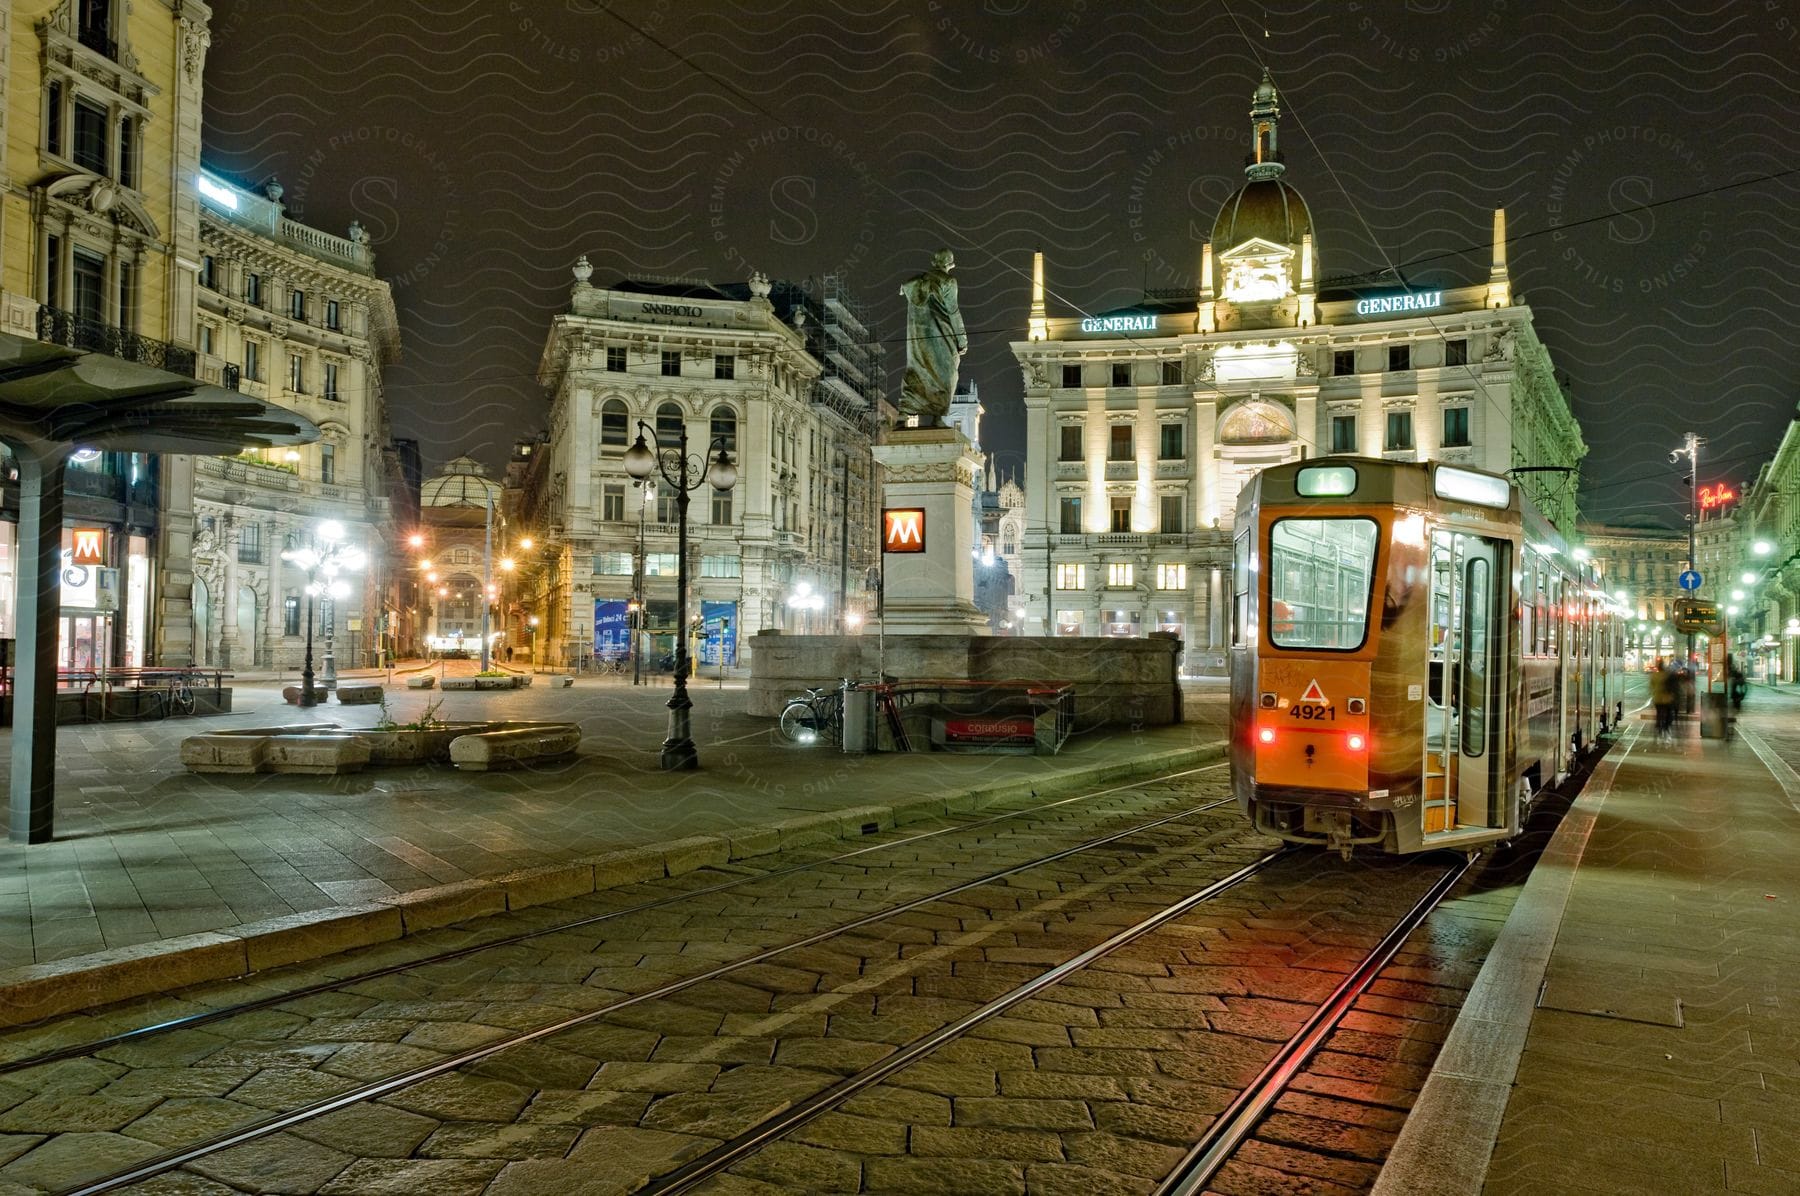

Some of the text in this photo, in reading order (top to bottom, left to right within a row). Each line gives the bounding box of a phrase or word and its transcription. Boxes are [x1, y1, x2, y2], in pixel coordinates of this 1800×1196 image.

[641, 303, 703, 318] SANPAOLO
[1357, 292, 1441, 315] GENERALI
[1081, 316, 1157, 332] GENERALI
[1699, 483, 1733, 507] Ray-Ban
[888, 517, 922, 543] M
[74, 535, 100, 557] M
[1289, 705, 1336, 721] 4921
[967, 724, 1018, 733] CORDUSIO
